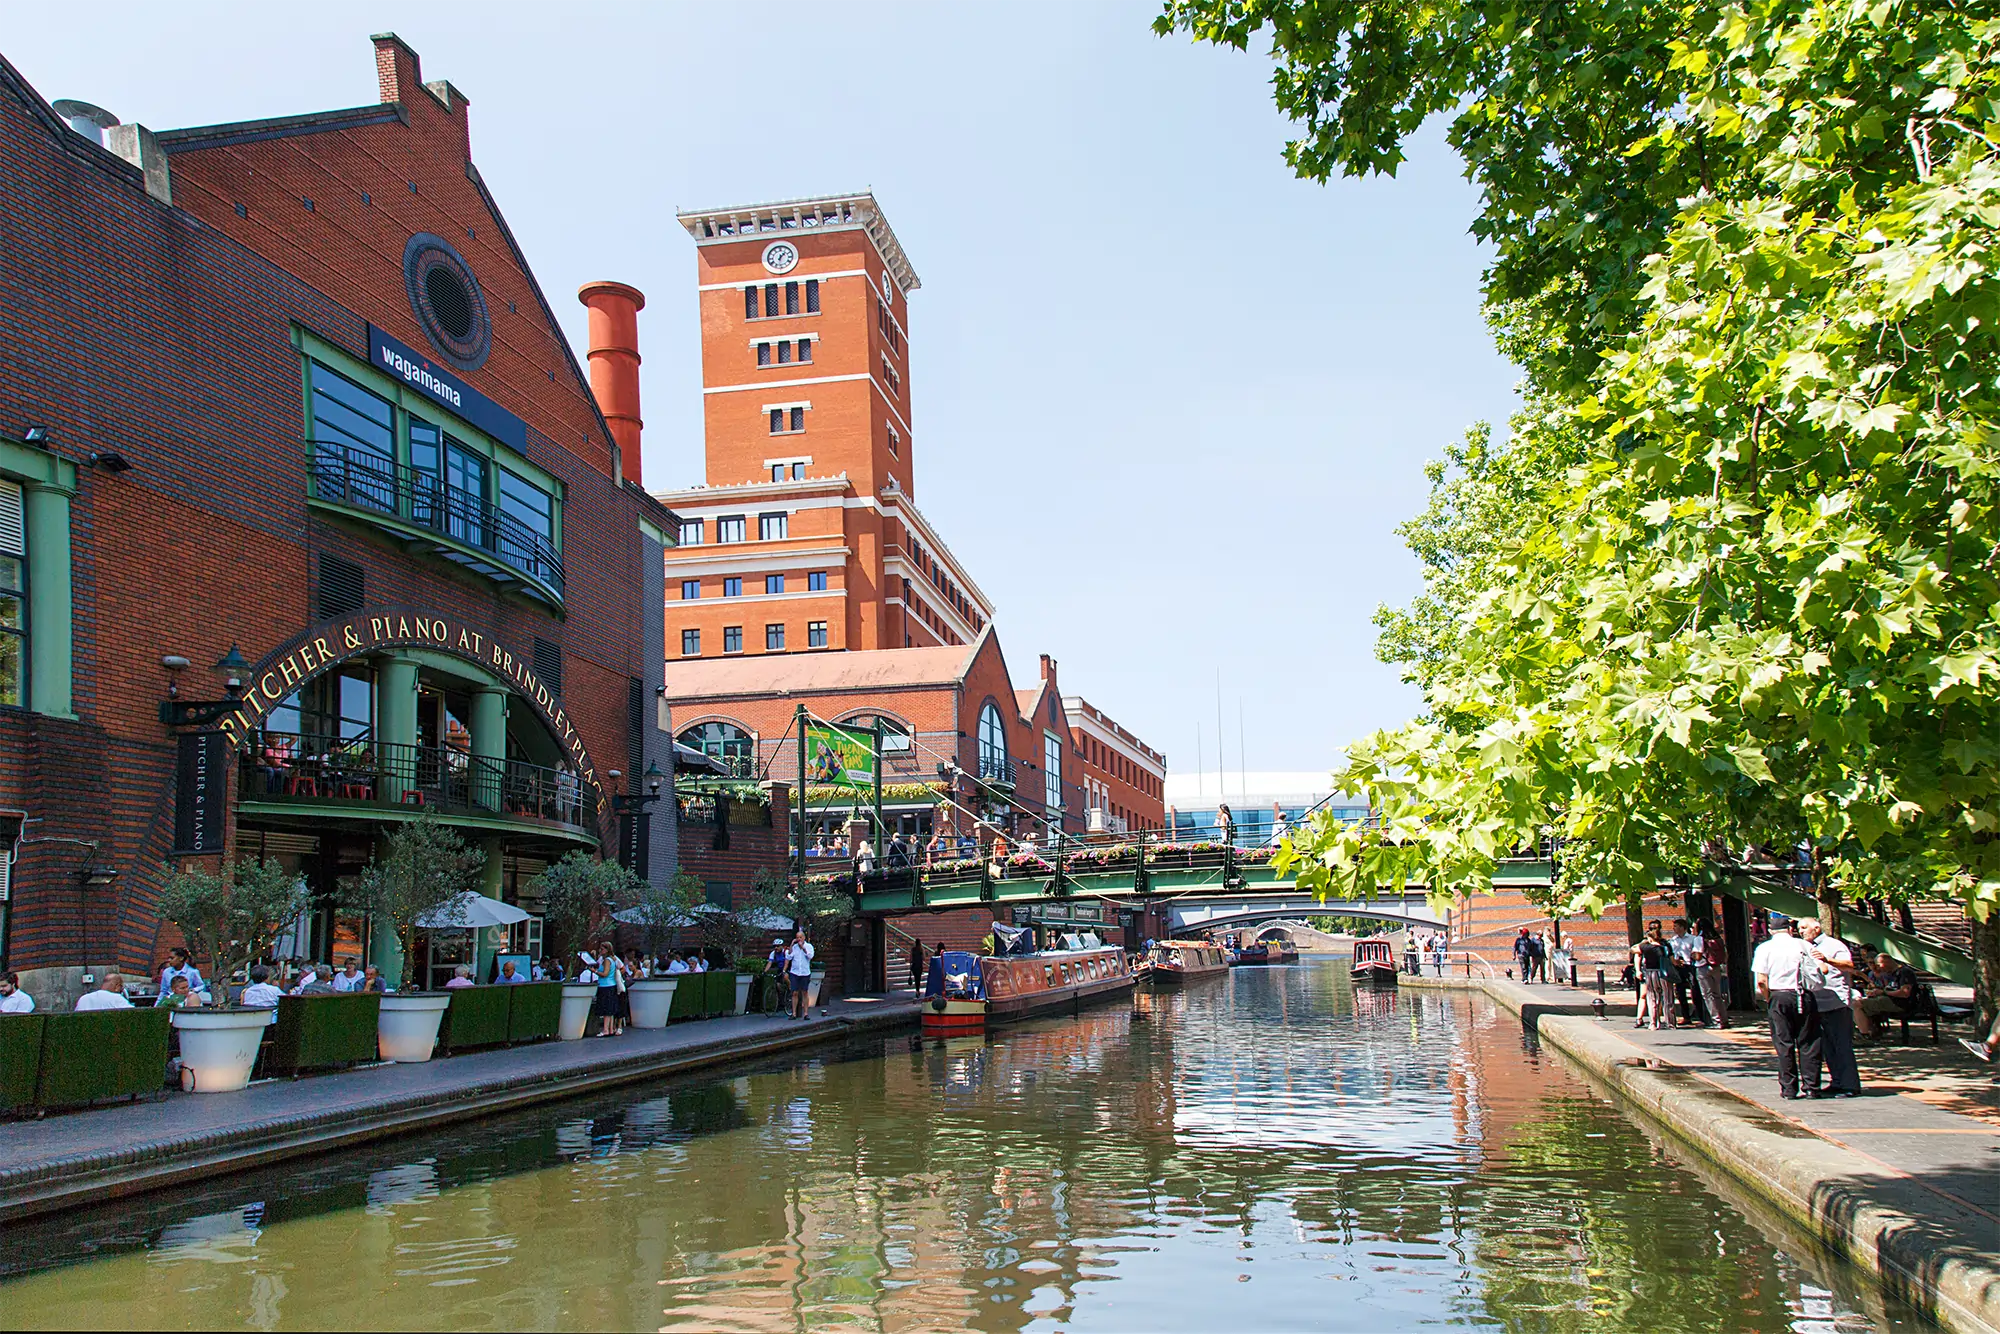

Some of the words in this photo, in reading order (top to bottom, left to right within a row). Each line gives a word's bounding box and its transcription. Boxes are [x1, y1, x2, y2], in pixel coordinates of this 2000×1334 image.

[382, 346, 461, 407] wagamama
[219, 637, 336, 745] PITCHER
[344, 624, 363, 649] &
[370, 616, 447, 642] PIANO
[458, 627, 482, 654] AT
[196, 736, 206, 790] PITCHER
[843, 754, 863, 769] FANS
[196, 795, 205, 804] &
[194, 809, 204, 850] PIANO
